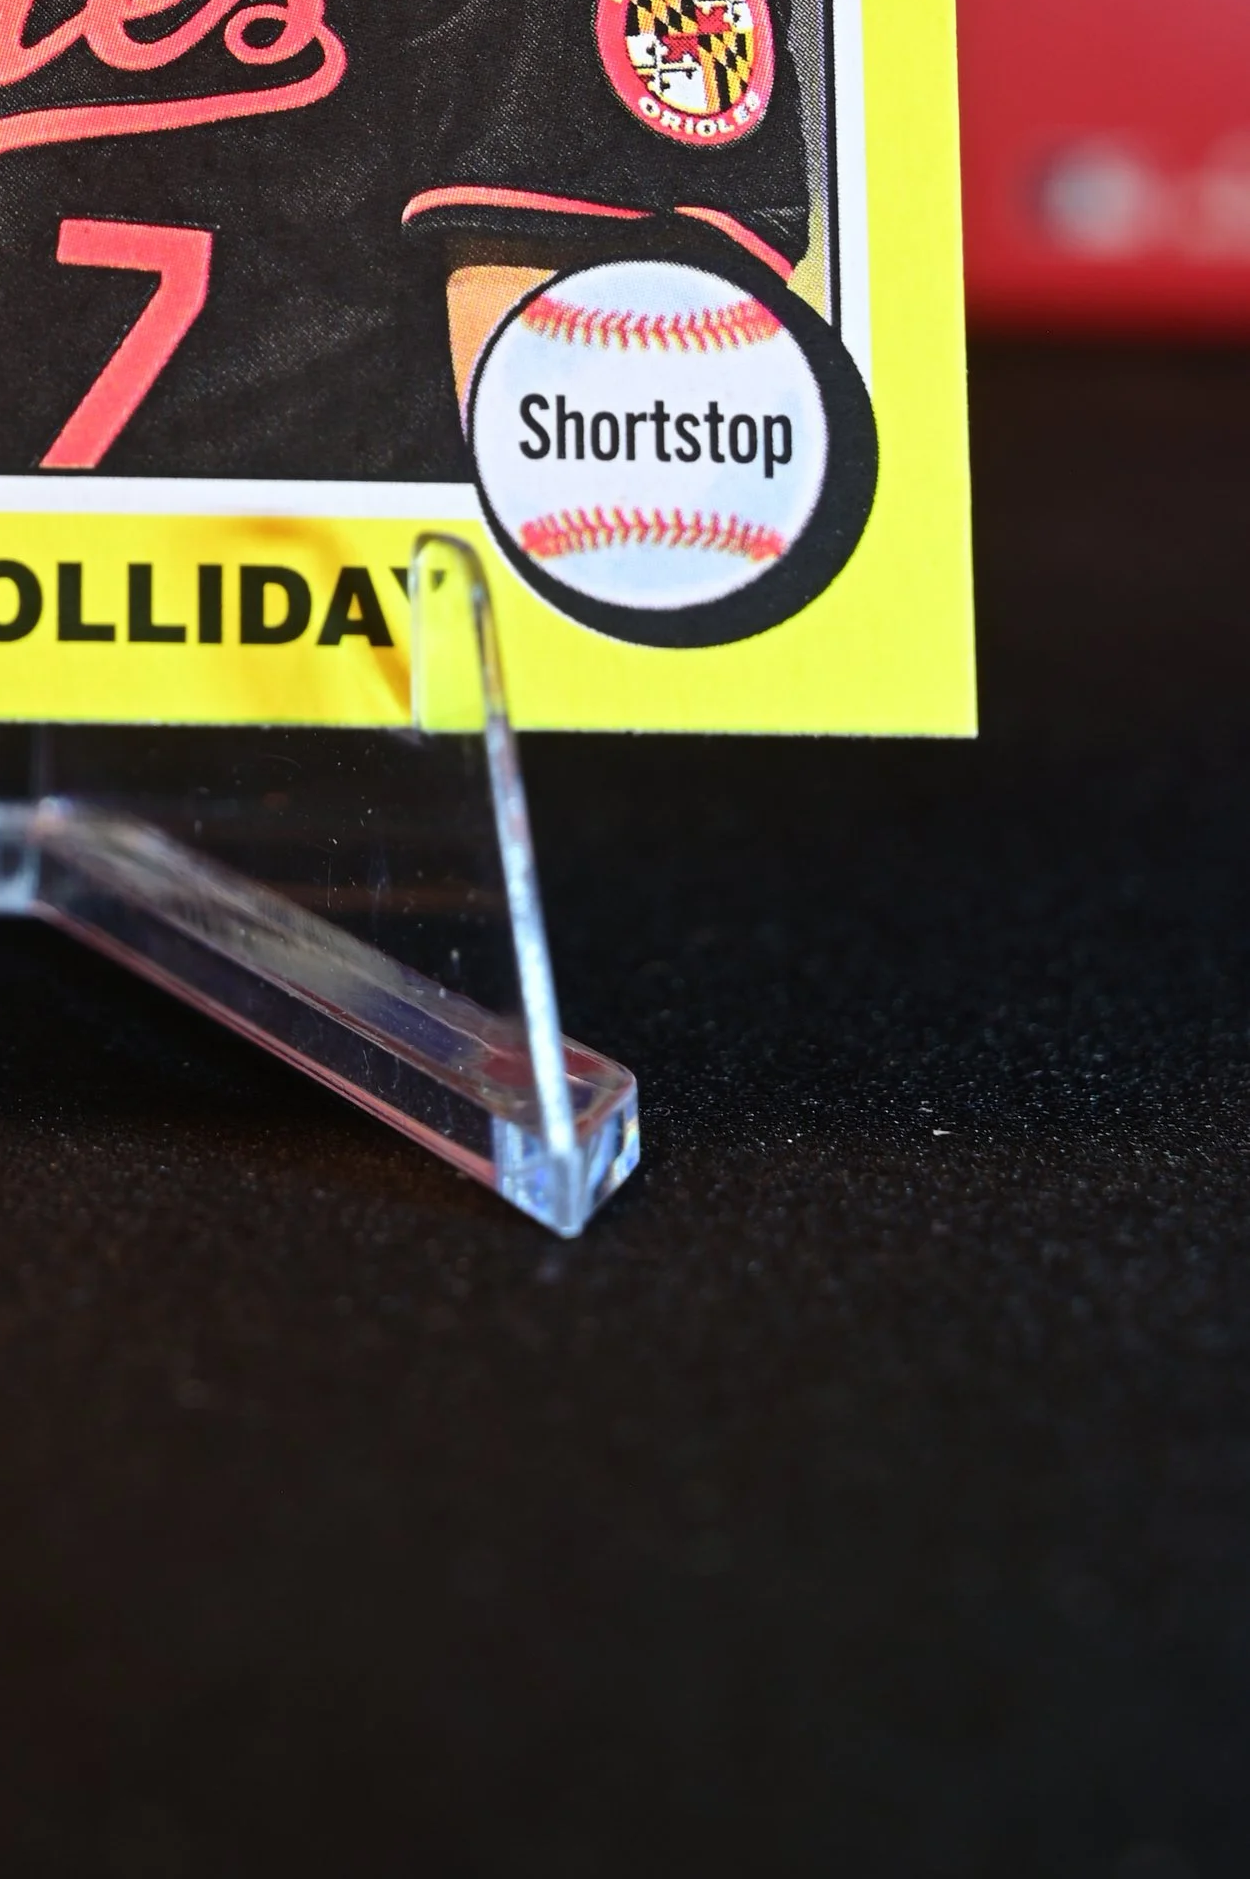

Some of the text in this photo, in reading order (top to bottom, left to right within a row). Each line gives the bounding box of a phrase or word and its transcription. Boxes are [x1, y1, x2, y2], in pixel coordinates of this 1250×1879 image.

[638, 90, 761, 139] ORIOLES
[40, 219, 212, 470] 7
[517, 393, 794, 479] Shortstop
